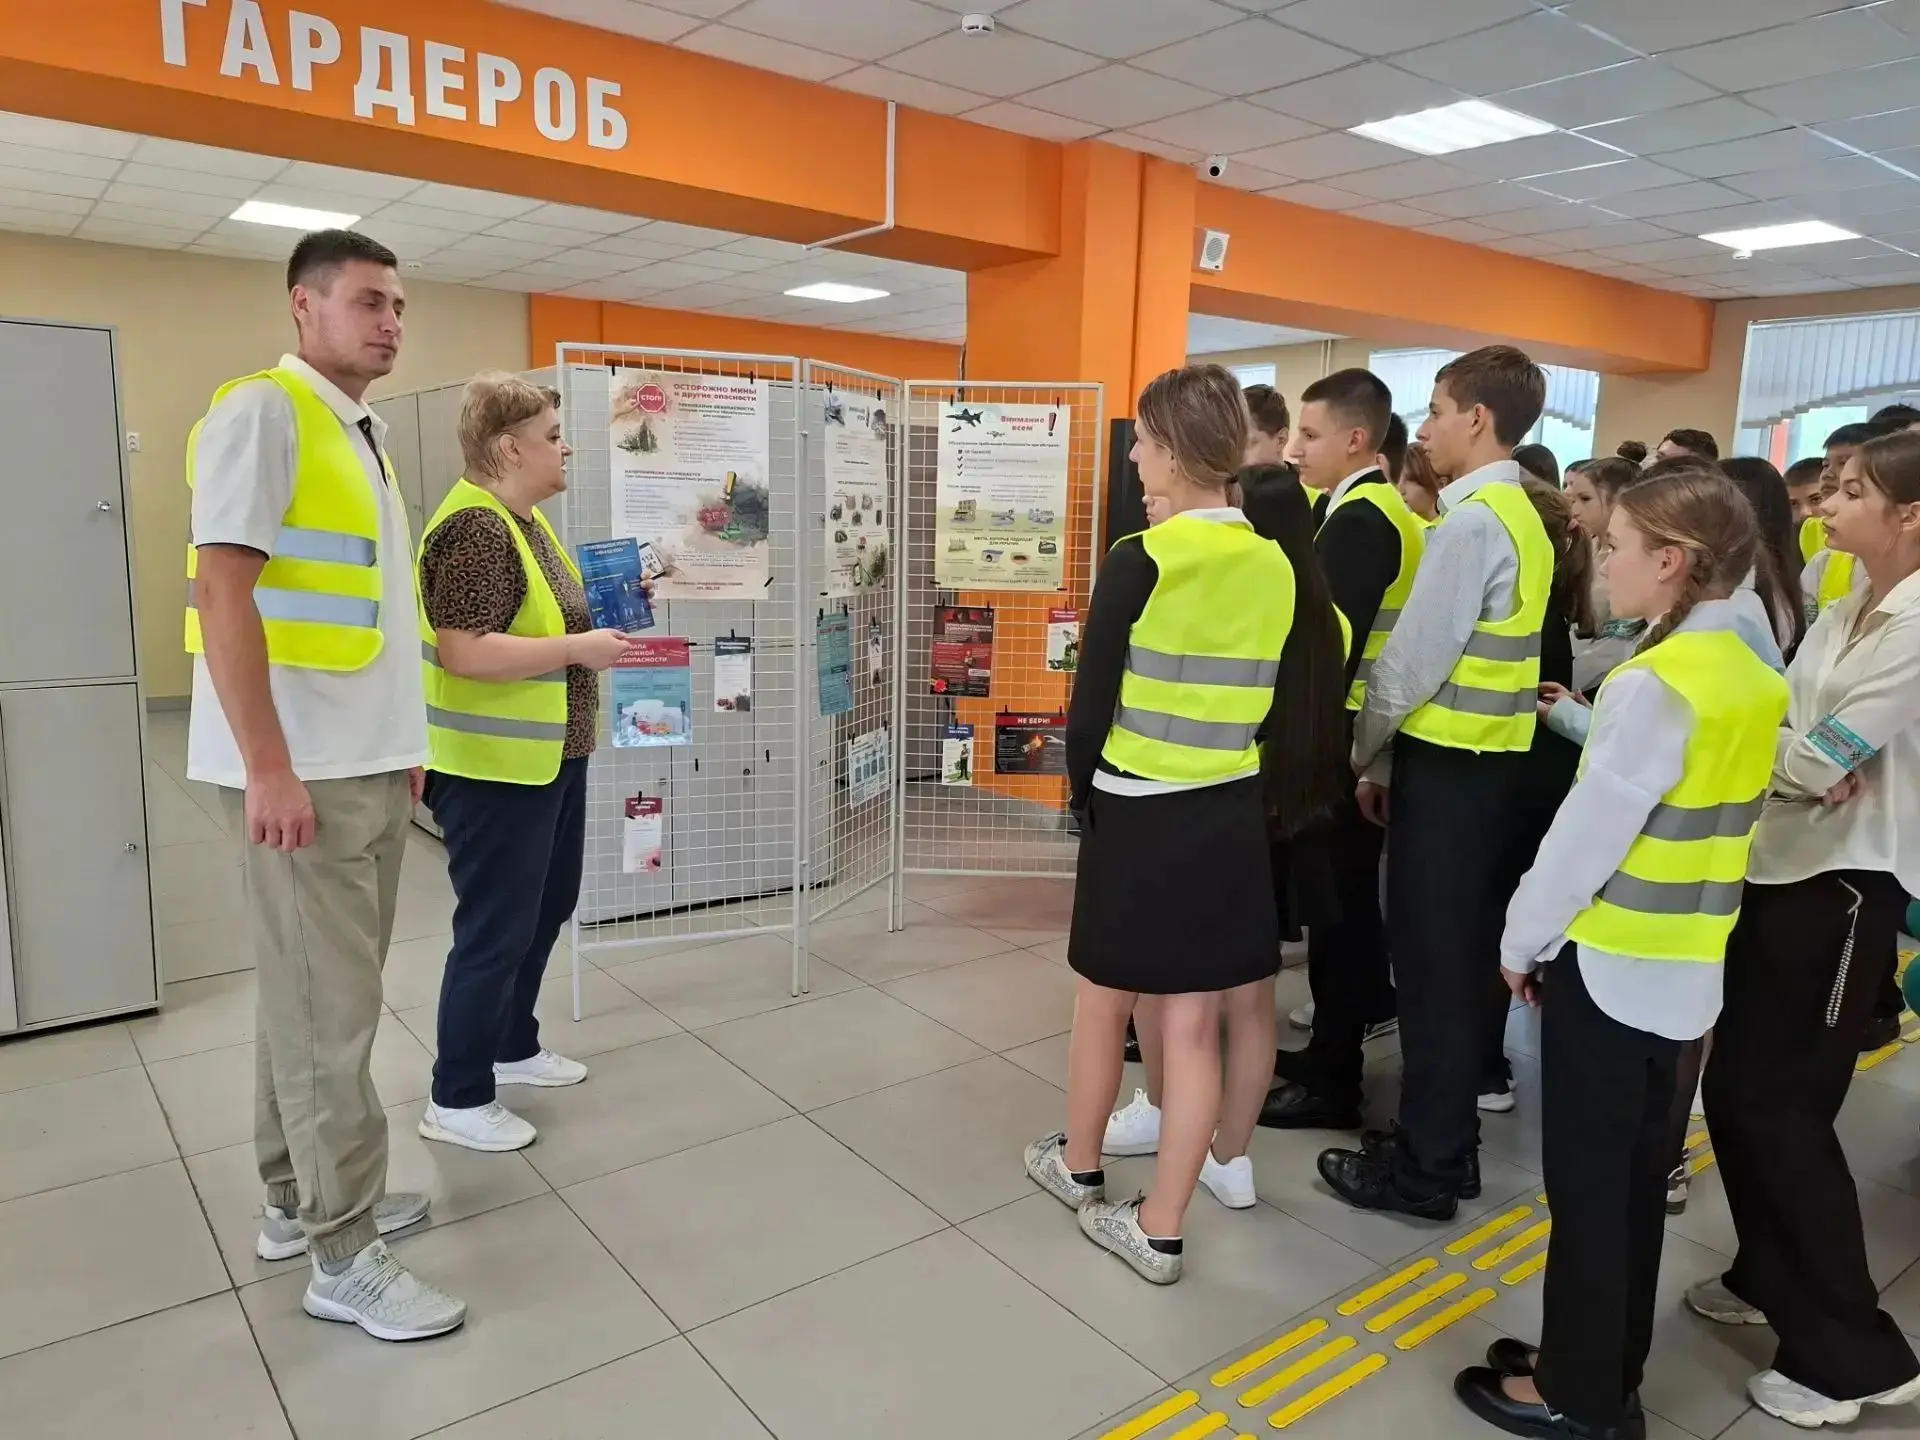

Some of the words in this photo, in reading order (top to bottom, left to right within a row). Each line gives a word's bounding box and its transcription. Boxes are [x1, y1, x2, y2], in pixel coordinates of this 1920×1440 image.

[160, 0, 628, 151] ГАРДЕРОБ
[673, 383, 728, 393] ОСТОРОЖНО
[730, 387, 757, 395] МИНЫ
